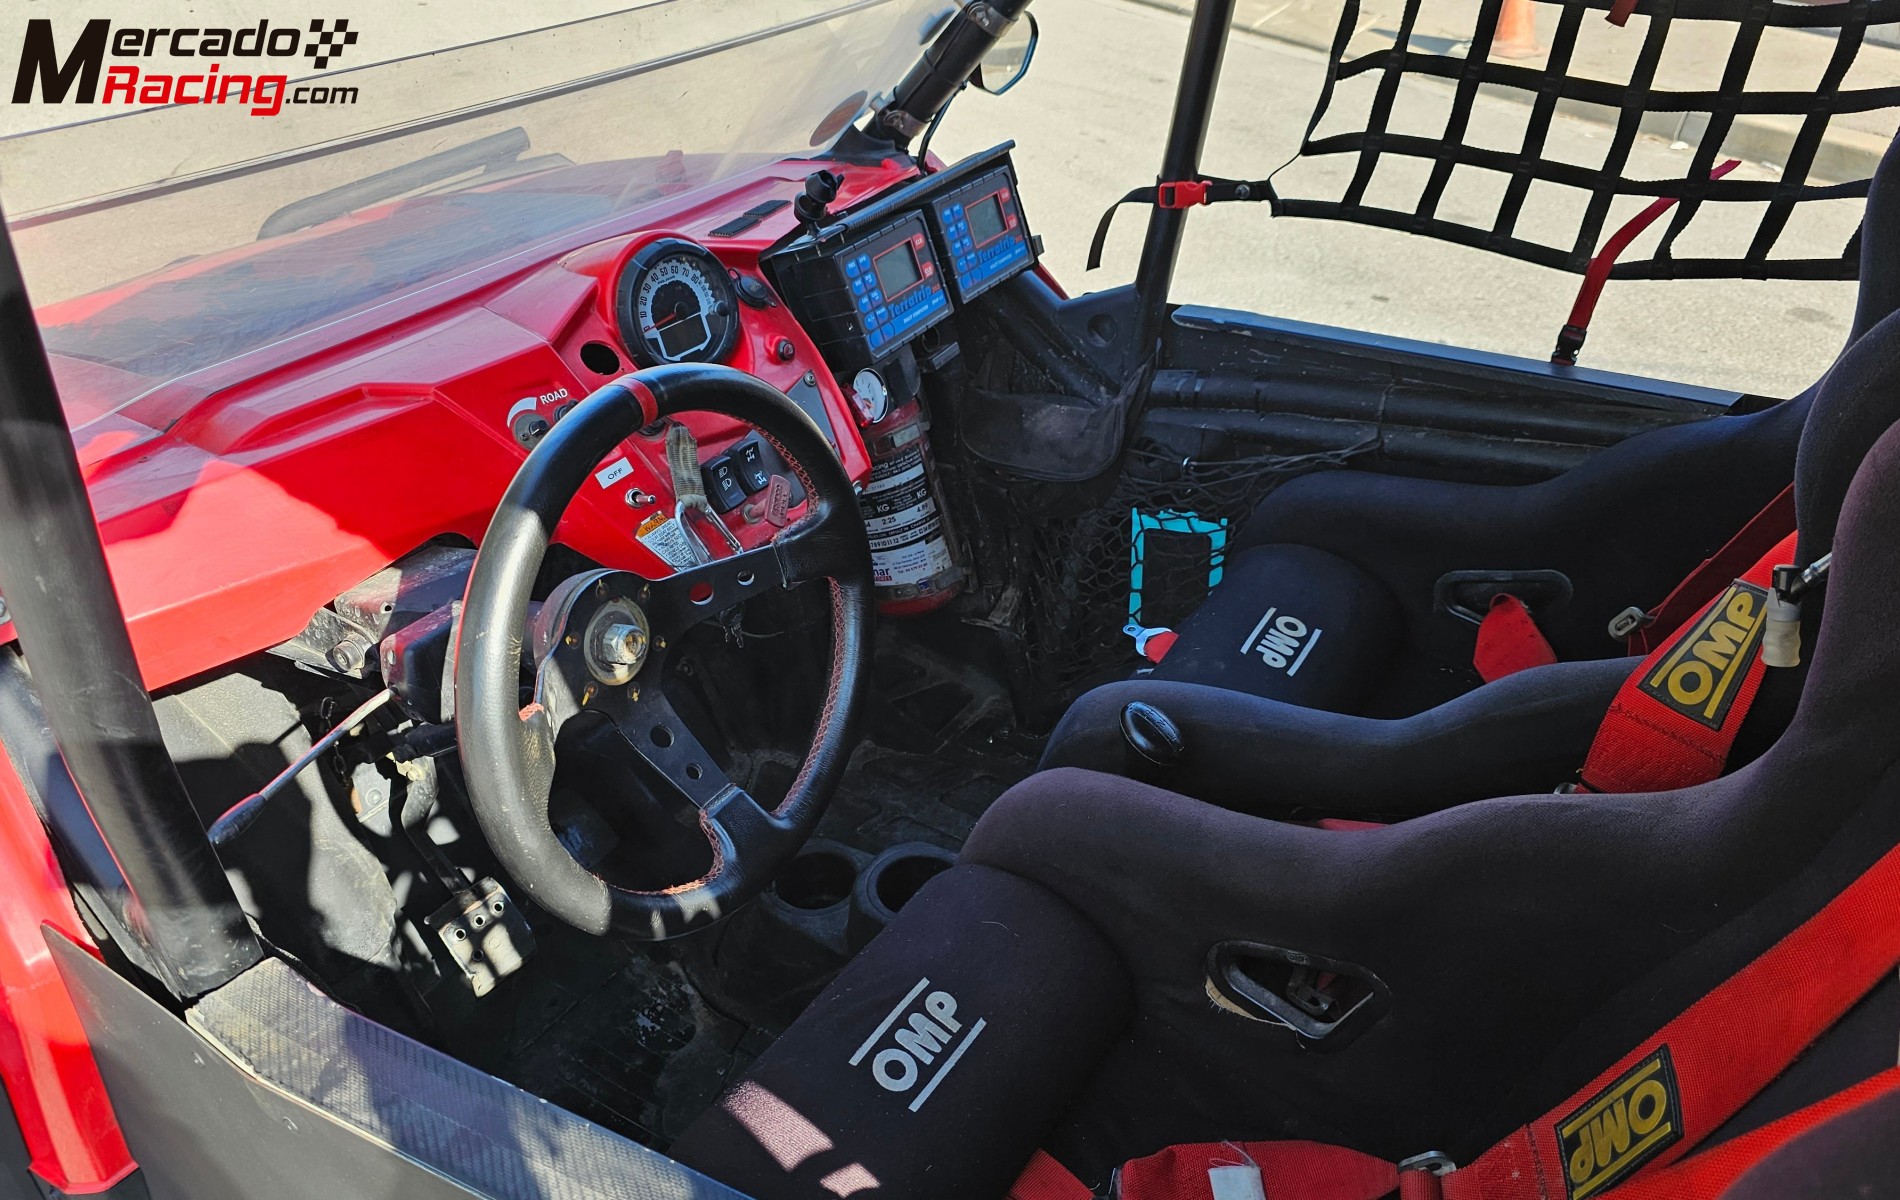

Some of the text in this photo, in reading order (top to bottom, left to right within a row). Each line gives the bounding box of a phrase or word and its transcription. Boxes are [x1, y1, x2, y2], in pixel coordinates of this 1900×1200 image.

[660, 267, 669, 277] 50
[670, 265, 679, 275] 60
[682, 267, 690, 278] 70
[650, 272, 659, 283] 40
[691, 273, 700, 285] 80
[643, 283, 652, 294] 30
[640, 296, 648, 307] 20
[888, 285, 931, 318] Terratrip
[640, 311, 648, 319] 10
[540, 388, 568, 405] ROAD
[607, 468, 623, 480] OFF
[916, 488, 927, 499] KG
[876, 503, 890, 513] KG
[1255, 615, 1307, 668] OMP
[1667, 591, 1756, 705] OMP
[872, 990, 963, 1092] OMP
[1569, 1079, 1667, 1183] OMP
